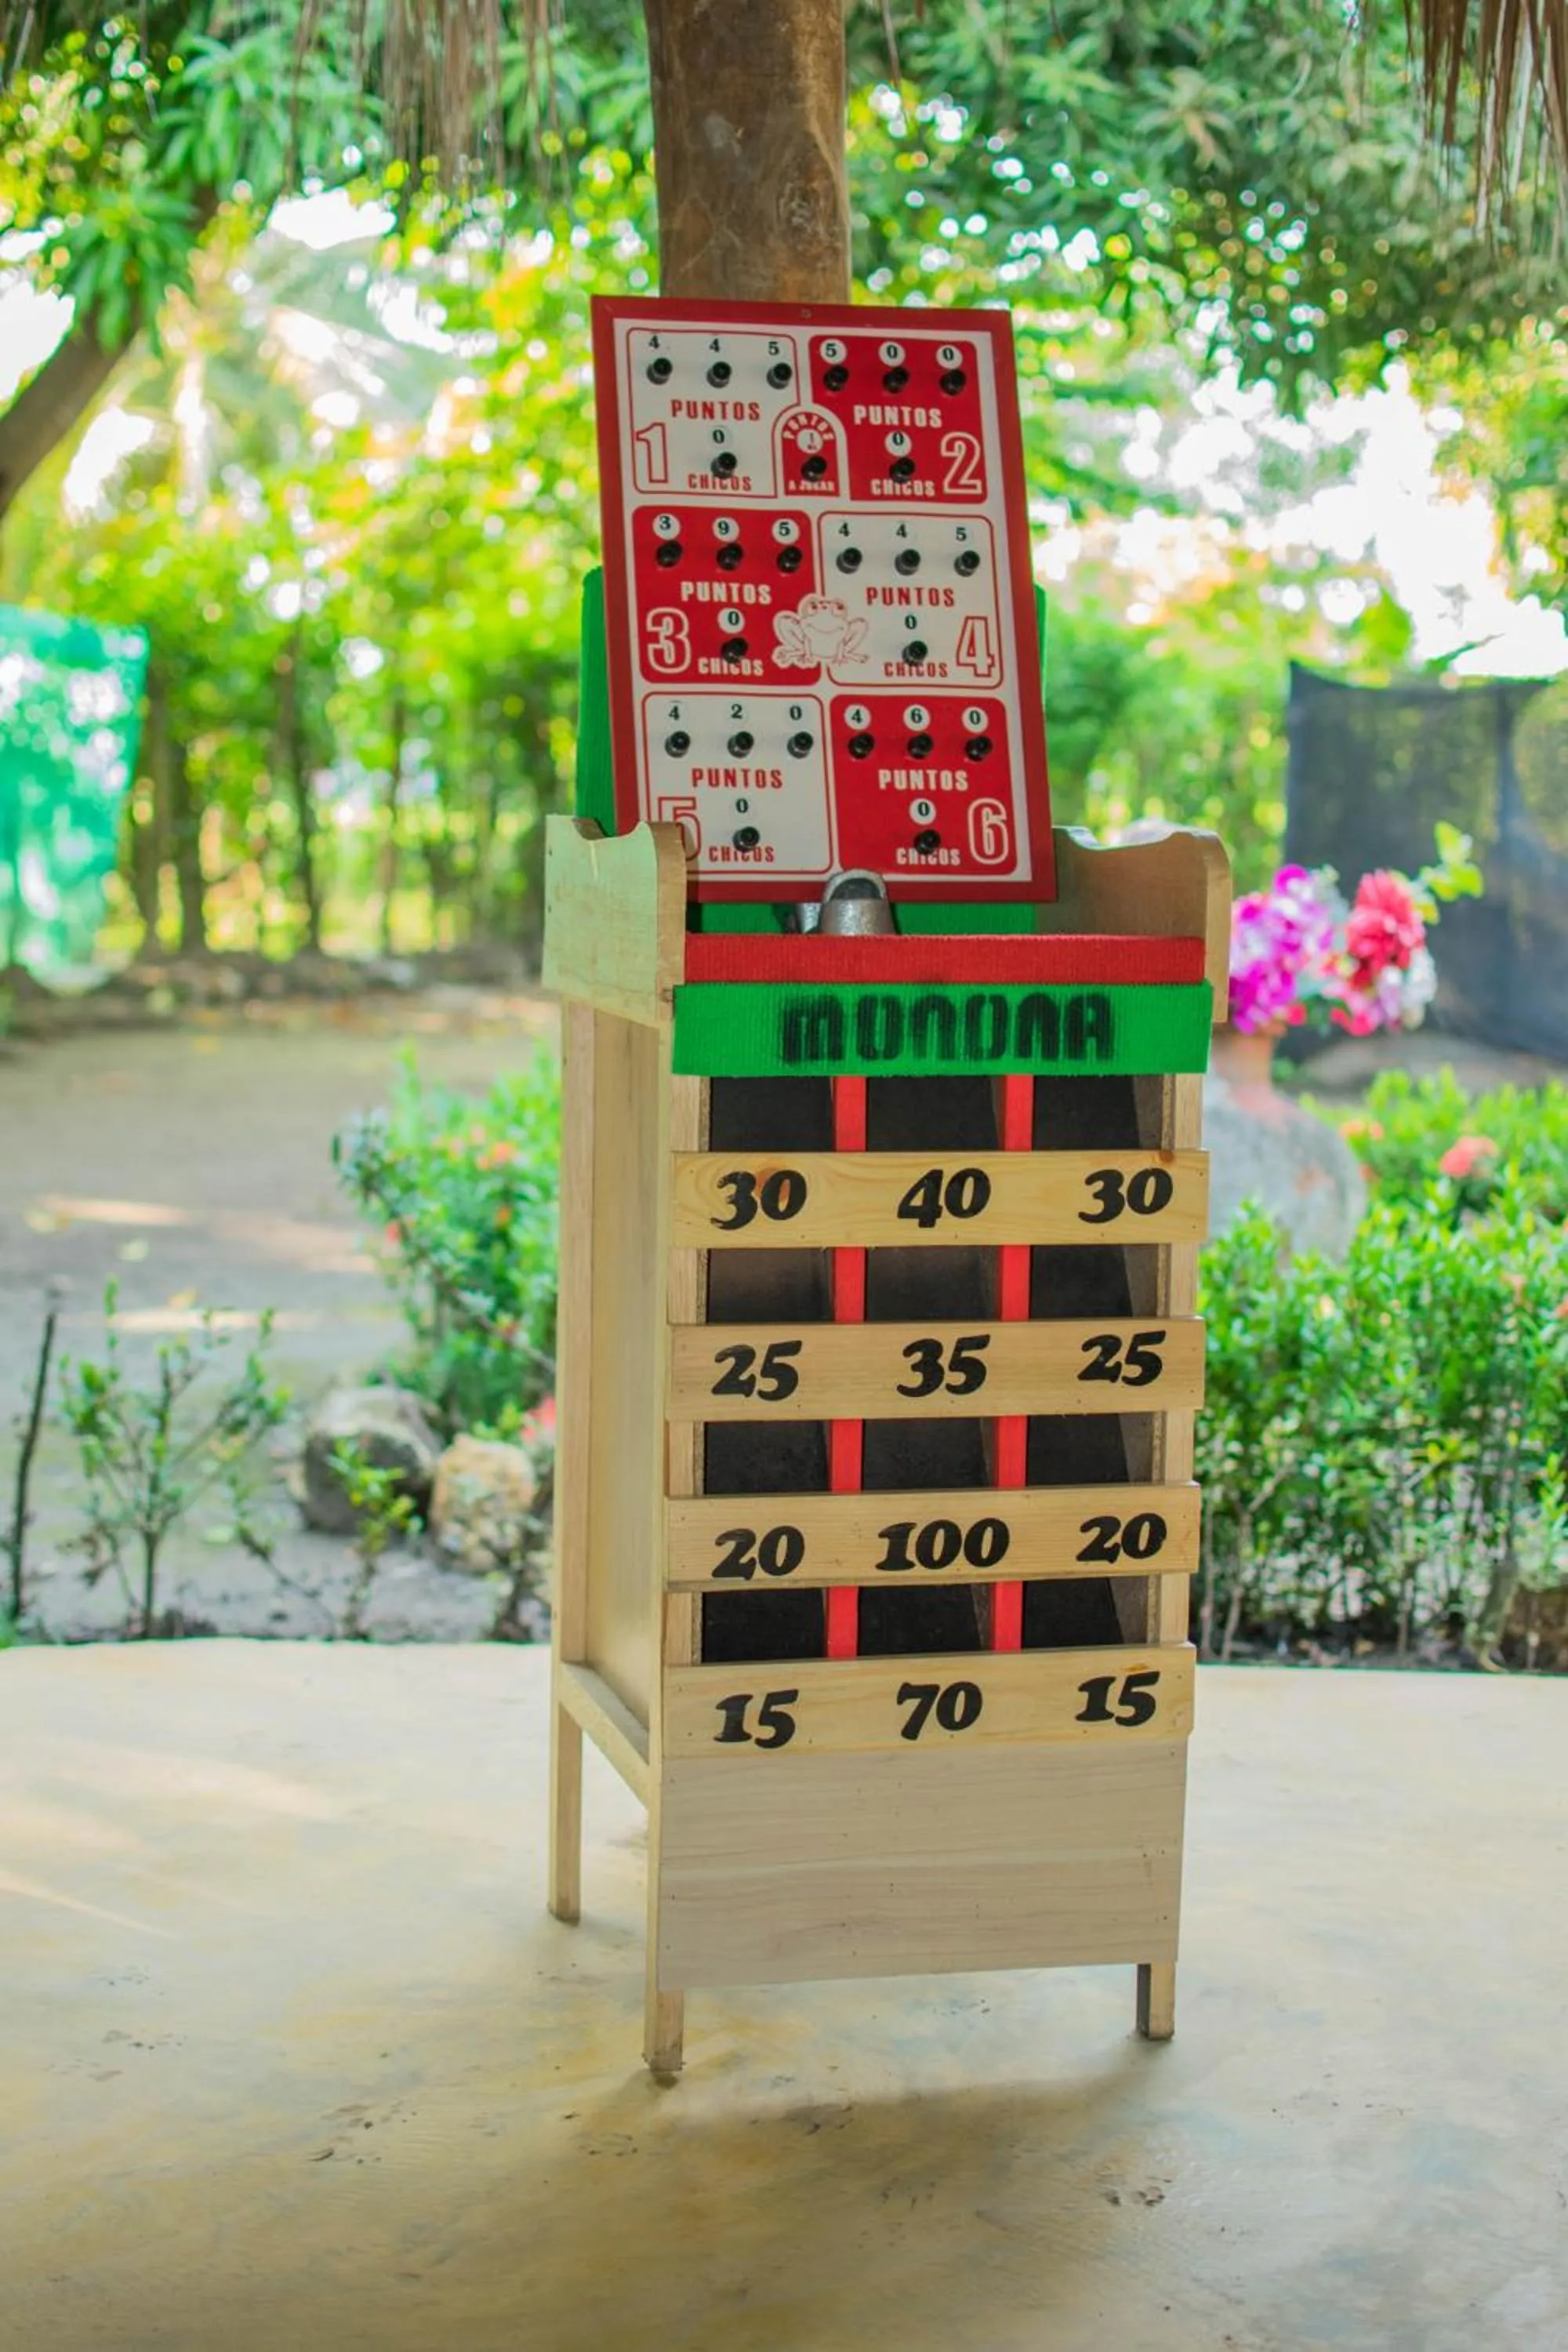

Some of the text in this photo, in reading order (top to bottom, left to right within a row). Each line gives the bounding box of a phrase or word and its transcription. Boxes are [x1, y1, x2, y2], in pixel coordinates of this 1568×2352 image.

[648, 334, 780, 356] 4 4 5
[825, 342, 955, 361] 5 0 0
[671, 399, 760, 422] PUNTOS
[853, 405, 942, 428] PUNTOS
[713, 429, 725, 445] 0
[782, 412, 835, 441] PUNTOS
[891, 430, 905, 447] 0
[636, 423, 668, 484] 1
[941, 432, 982, 495] 2
[687, 474, 752, 491] CHICOS
[870, 478, 935, 497] CHICOS
[659, 514, 791, 538] 3 9 5
[838, 523, 967, 542] 4 4 5
[681, 581, 771, 605] PUNTOS
[866, 586, 955, 608] PUNTOS
[728, 610, 741, 626] 0
[904, 614, 917, 630] 0
[646, 607, 691, 673] 3
[956, 616, 996, 677] 4
[698, 657, 764, 677] CHICOS
[884, 662, 948, 678] CHICOS
[668, 704, 802, 721] 4 2 0
[851, 707, 982, 726] 4 6 0
[692, 768, 782, 789] PUNTOS
[878, 768, 968, 791] PUNTOS
[735, 798, 749, 814] 0
[916, 801, 931, 818] 0
[658, 796, 702, 862] 5
[967, 797, 1009, 865] 6
[709, 846, 775, 863] CHICOS
[895, 847, 961, 866] CHICOS
[710, 1167, 1174, 1230] 30 40 30
[710, 1330, 1167, 1401] 25 35 25
[710, 1512, 1168, 1581] 20 100 20
[712, 1670, 1161, 1749] 15 70 15
